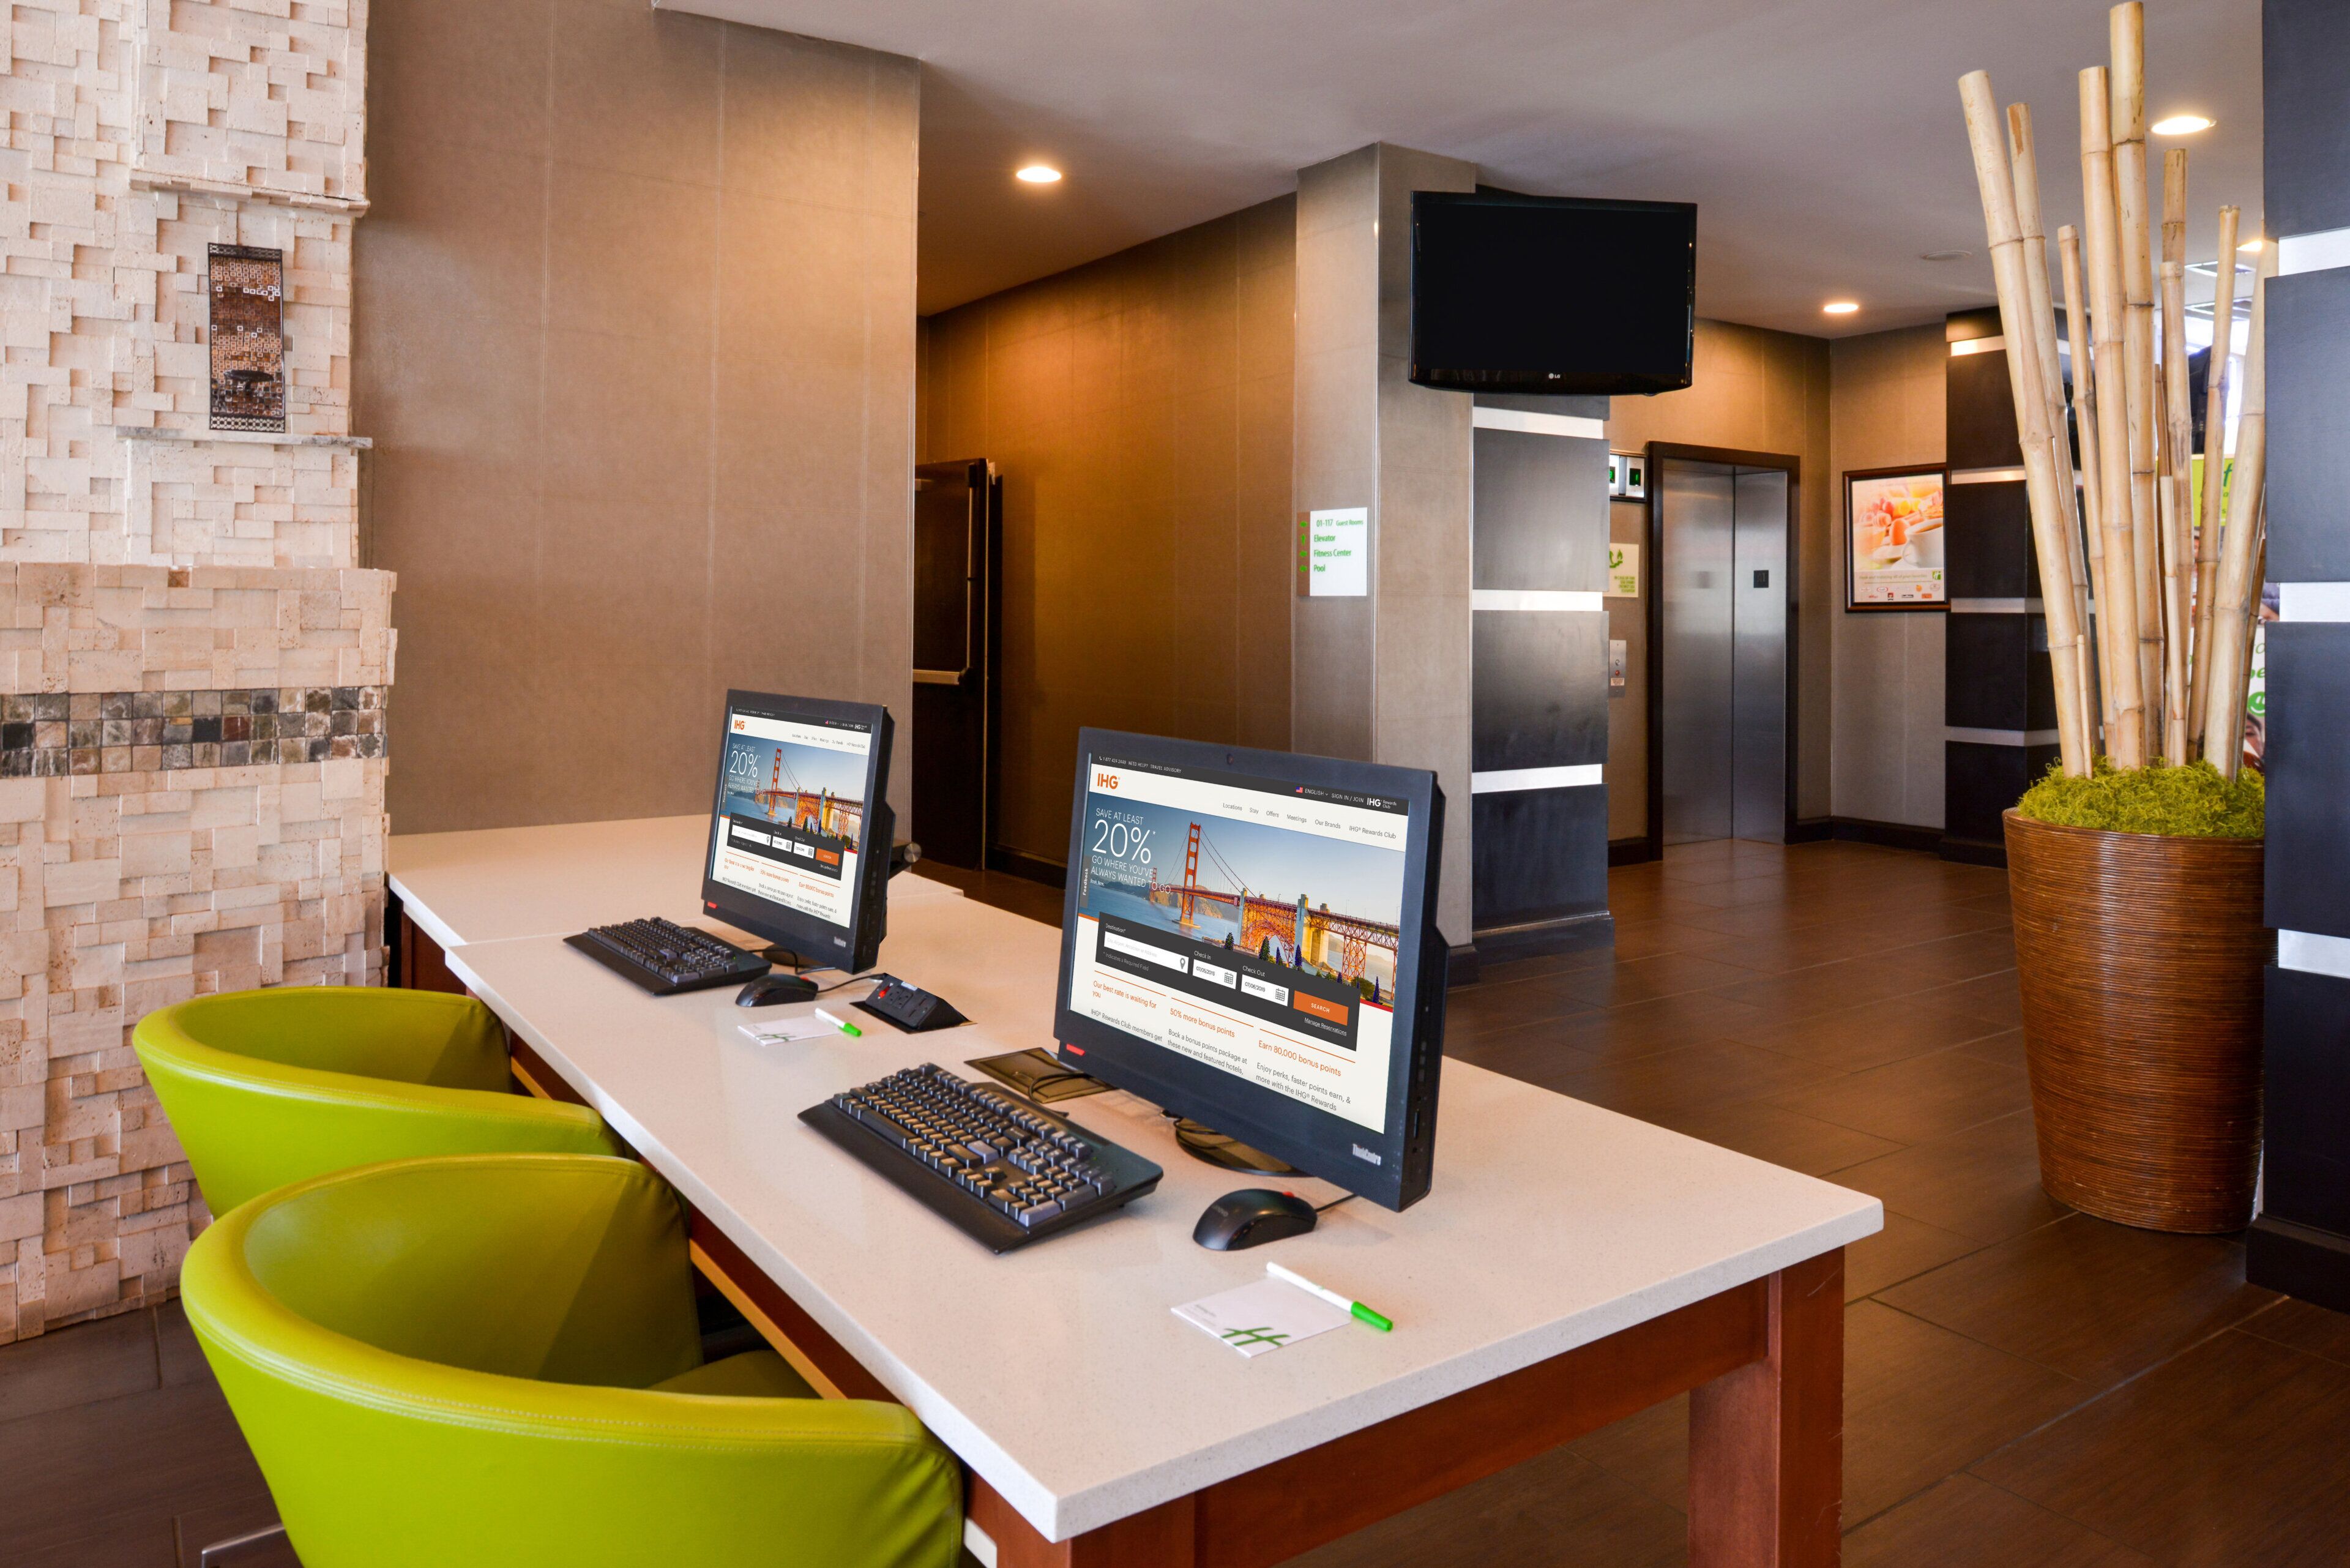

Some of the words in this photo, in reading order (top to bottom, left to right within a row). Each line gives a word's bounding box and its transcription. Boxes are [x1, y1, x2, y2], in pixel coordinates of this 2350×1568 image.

[1333, 548, 1352, 557] Center
[1313, 564, 1326, 572] Pool
[734, 720, 745, 730] IHG
[1367, 797, 1381, 807] IHG
[1095, 808, 1112, 819] SAVE
[1113, 812, 1122, 821] AT
[1123, 813, 1144, 826] LEAST
[1223, 802, 1242, 811] Locations
[1286, 813, 1307, 823] Meetings
[1324, 821, 1341, 829] Brands
[1362, 827, 1383, 837] Rewards
[1092, 855, 1102, 865] GO
[1104, 857, 1127, 872] WHERE
[1129, 864, 1154, 878] YOU'VE
[1091, 866, 1116, 879] ALWAYS
[1117, 872, 1146, 887] WANTED
[1148, 880, 1158, 890] TO
[1124, 958, 1140, 969] Required
[1194, 950, 1206, 959] Check
[1242, 965, 1256, 974] Check
[1092, 990, 1101, 999] you
[1103, 983, 1114, 993] best
[1114, 988, 1124, 996] rate
[1130, 995, 1147, 1007] waiting
[1311, 1002, 1330, 1013] SEARCH
[1102, 1013, 1120, 1025] Rewards
[1121, 1020, 1131, 1029] Club
[1132, 1025, 1154, 1039] members
[1170, 1008, 1182, 1018] 50%
[1183, 1014, 1198, 1024] more
[1198, 1018, 1215, 1031] bonus
[1217, 1026, 1235, 1038] points
[1304, 1017, 1320, 1028] Manage
[1321, 1023, 1347, 1036] Reservations
[1168, 1029, 1180, 1039] Book
[1185, 1035, 1201, 1047] bonus
[1202, 1042, 1218, 1053] points
[1218, 1048, 1240, 1062] package
[1168, 1039, 1181, 1050] these
[1193, 1050, 1203, 1058] and
[1203, 1053, 1225, 1067] featured
[1226, 1061, 1244, 1075] hotels,
[1258, 1040, 1272, 1051] Earn
[1274, 1046, 1297, 1060] 80,000
[1298, 1054, 1319, 1069] bonus
[1320, 1062, 1341, 1077] points
[1256, 1062, 1272, 1073] Enjoy
[1273, 1069, 1290, 1081] perks,
[1291, 1075, 1308, 1087] faster
[1309, 1083, 1328, 1096] points
[1329, 1091, 1345, 1102] earn,
[1256, 1074, 1270, 1085] more
[1271, 1080, 1284, 1091] with
[1285, 1084, 1294, 1094] the
[1311, 1095, 1337, 1111] Rewards
